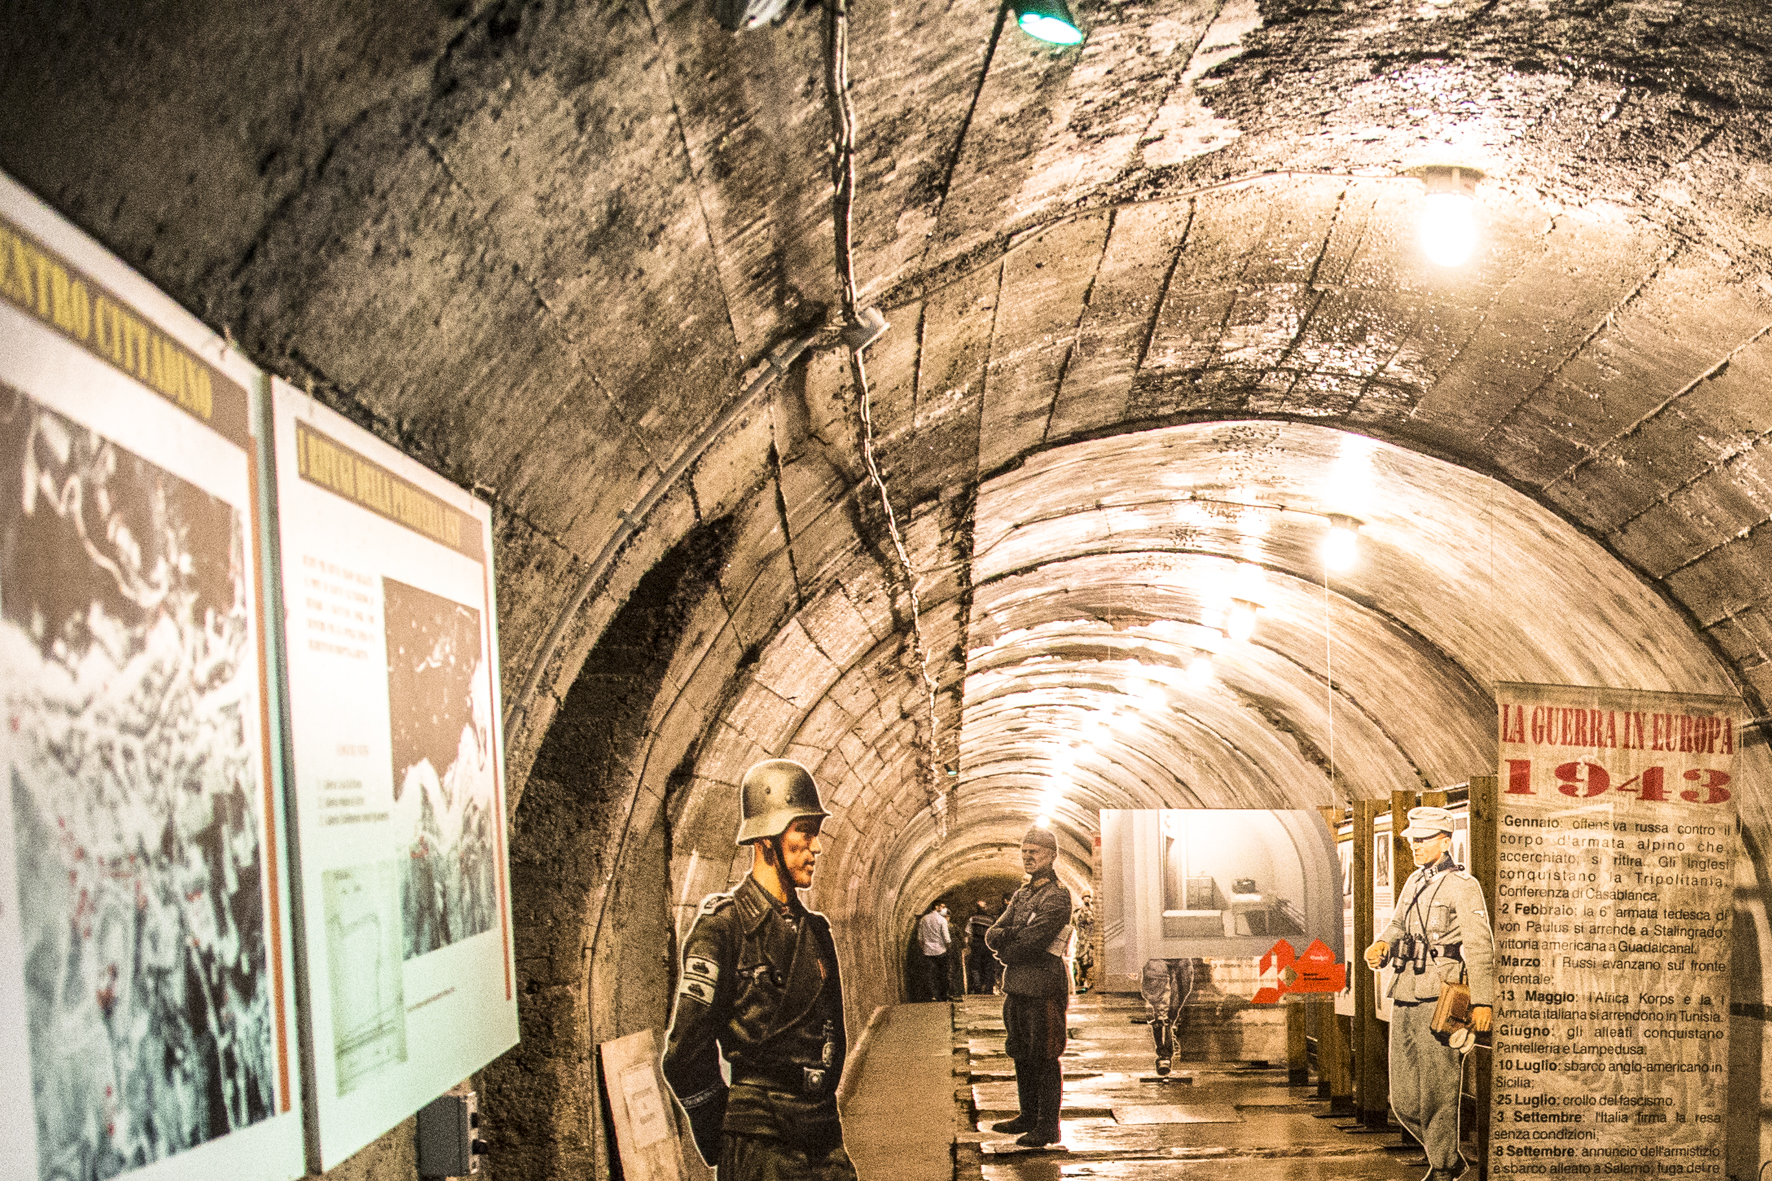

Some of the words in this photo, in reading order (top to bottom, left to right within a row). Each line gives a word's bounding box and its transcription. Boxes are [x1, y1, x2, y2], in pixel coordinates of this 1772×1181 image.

[95, 296, 212, 419] CITTADINO
[1502, 704, 1525, 744] LA
[1531, 705, 1617, 749] GUERRA
[1623, 711, 1647, 751] IN
[1652, 713, 1733, 755] EUROPA
[1504, 759, 1732, 804] 1943
[1635, 823, 1668, 833] russa
[1677, 825, 1715, 835] contro
[1724, 824, 1730, 836] il
[1500, 835, 1543, 847] corpo
[1557, 835, 1624, 848] d'armata
[1637, 839, 1685, 852] alpino
[1500, 852, 1579, 865] accerchiato,
[1658, 856, 1676, 867] Gli
[1687, 858, 1729, 872] Inglesi
[1499, 869, 1596, 882] conquistano
[1609, 872, 1621, 883] la
[1499, 885, 1569, 897] Conferenza
[1572, 886, 1583, 898] di
[1586, 888, 1660, 901] Casablanca.
[1515, 903, 1577, 916] Febbraio:
[1584, 905, 1594, 917] la
[1616, 909, 1658, 919] armata
[1663, 909, 1710, 920] tedesca
[1716, 910, 1728, 921] di
[1499, 922, 1520, 932] von
[1526, 921, 1569, 933] Paulus
[1574, 924, 1584, 934] si
[1589, 924, 1635, 936] arrende
[1640, 927, 1648, 936] a
[1499, 938, 1539, 950] vittoria
[1541, 939, 1606, 951] americana
[1608, 943, 1616, 951] a
[1618, 940, 1697, 954] Guadalcanal.
[1562, 956, 1597, 968] Russi
[1602, 960, 1661, 970] avanzano
[1667, 960, 1685, 971] sul
[1690, 960, 1726, 972] fronte
[1525, 990, 1578, 1004] Maggio:
[1639, 993, 1675, 1006] Korps
[1683, 996, 1691, 1005] e
[1700, 995, 1711, 1005] la
[1497, 1007, 1540, 1019] Armata
[1543, 1008, 1587, 1020] italiana
[1589, 1011, 1599, 1020] si
[1601, 1010, 1664, 1021] arrendono
[1666, 1010, 1676, 1021] in
[1679, 1010, 1724, 1022] Tunisia.
[1567, 1026, 1583, 1039] gli
[1594, 1026, 1632, 1037] alleati
[1644, 1028, 1724, 1040] conquistano
[1496, 1042, 1560, 1054] Pantelleria
[1562, 1045, 1570, 1054] e
[1572, 1043, 1647, 1056] Lampedusa.
[1515, 1060, 1561, 1073] Luglio:
[1563, 1060, 1606, 1072] sbarco
[1608, 1060, 1709, 1074] anglo-americano
[1711, 1063, 1722, 1072] in
[1496, 1076, 1534, 1089] Sicilia;
[1515, 1093, 1560, 1108] Luglio:
[1562, 1094, 1597, 1106] crollo
[1599, 1094, 1617, 1106] del
[1620, 1095, 1675, 1106] fascismo.
[1514, 1110, 1585, 1123] Settembre:
[1595, 1111, 1628, 1123] l'Italia
[1637, 1111, 1666, 1123] firma
[1676, 1112, 1686, 1123] la
[1694, 1114, 1721, 1123] resa
[1494, 1130, 1530, 1140] senza
[1506, 1145, 1578, 1158] Settembre:
[1582, 1147, 1638, 1157] annuncio
[1640, 1145, 1720, 1157] dell'armistizio
[1493, 1164, 1500, 1174] e
[1502, 1162, 1547, 1174] sbarco
[1549, 1163, 1591, 1174] alleato
[1593, 1165, 1601, 1174] a
[1657, 1163, 1684, 1176] fuga
[1686, 1163, 1704, 1174] del
[1707, 1164, 1720, 1174] re
